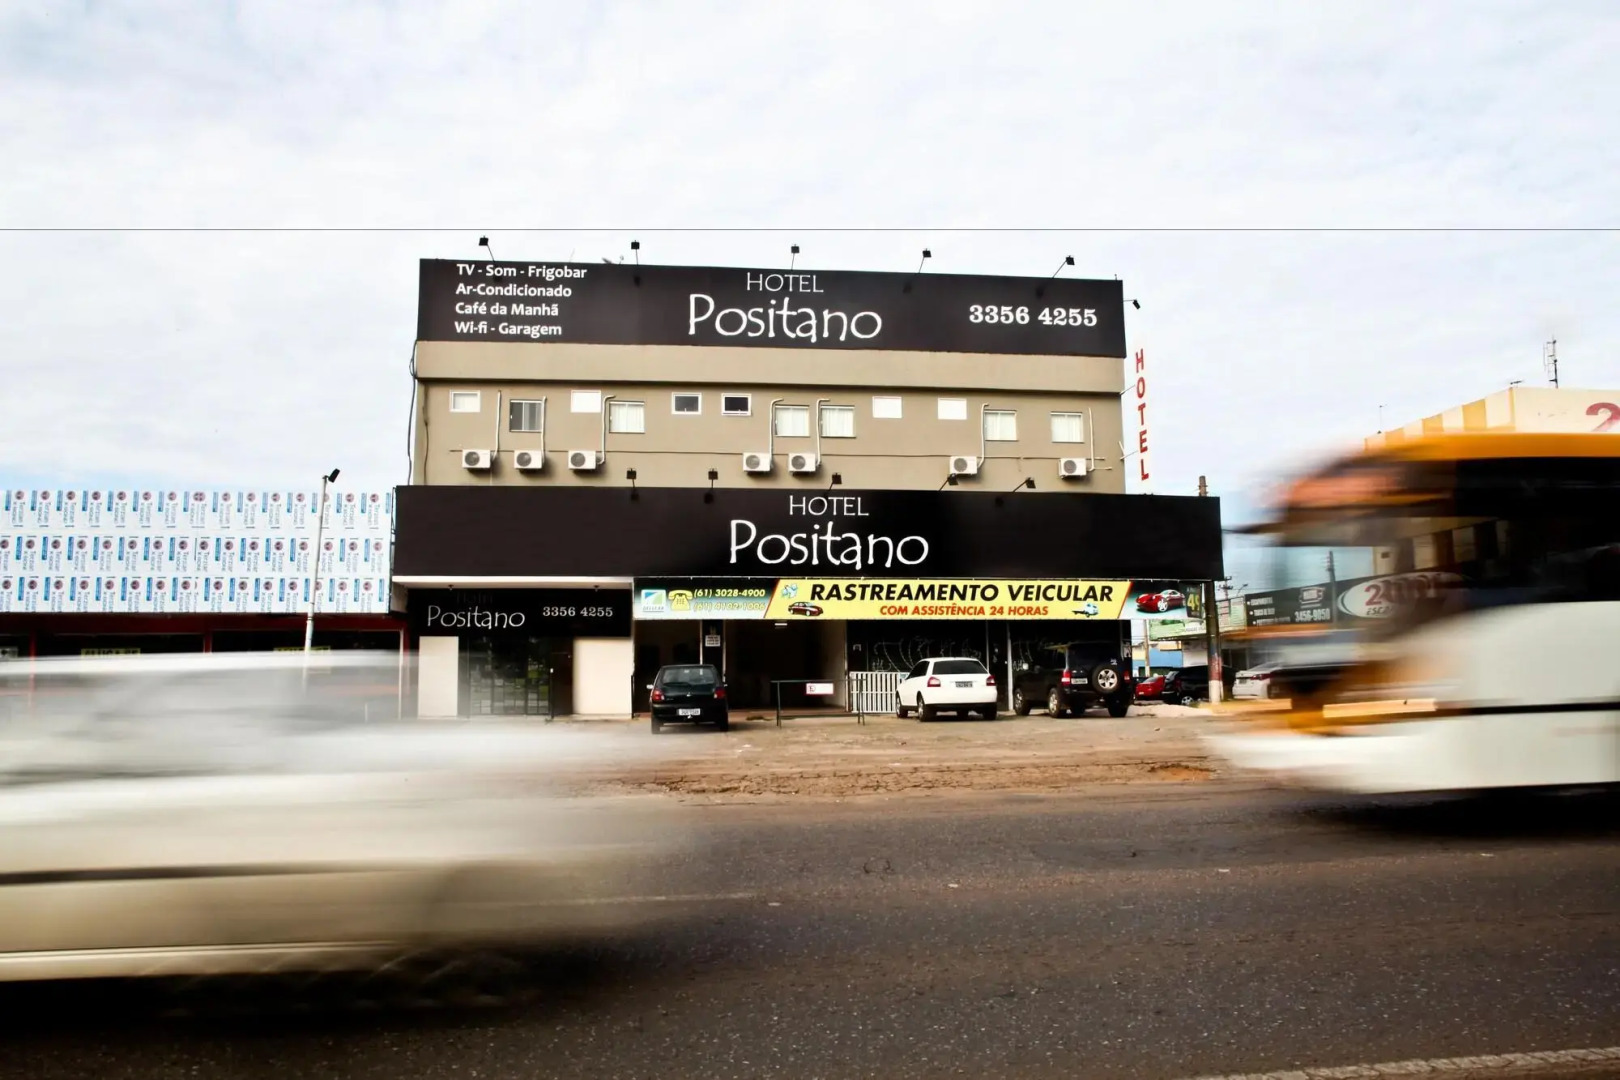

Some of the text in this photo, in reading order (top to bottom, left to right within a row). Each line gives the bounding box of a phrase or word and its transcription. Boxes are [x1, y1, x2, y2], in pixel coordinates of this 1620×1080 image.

[457, 264, 476, 276] TV
[485, 265, 516, 278] Som
[528, 265, 588, 281] Frigobar
[455, 283, 572, 298] Ar-Condicionado
[746, 272, 823, 293] HOTEL
[455, 302, 559, 317] Café da Manhã
[688, 293, 883, 343] Positano
[968, 305, 1098, 327] 3356 4255
[454, 321, 487, 334] Wi-fi
[498, 323, 563, 338] Garagem
[1135, 348, 1149, 481] HOTEL
[789, 495, 869, 516] HOTEL
[729, 519, 929, 570] Positano
[693, 588, 765, 600] (61) 3028-4900
[811, 584, 1113, 602] RASTREAMENTO VEICULAR
[427, 605, 526, 629] Positano
[543, 606, 613, 617] 3356 4255
[880, 602, 1049, 617] COM ASSISTÊNCIA 24 HORAS
